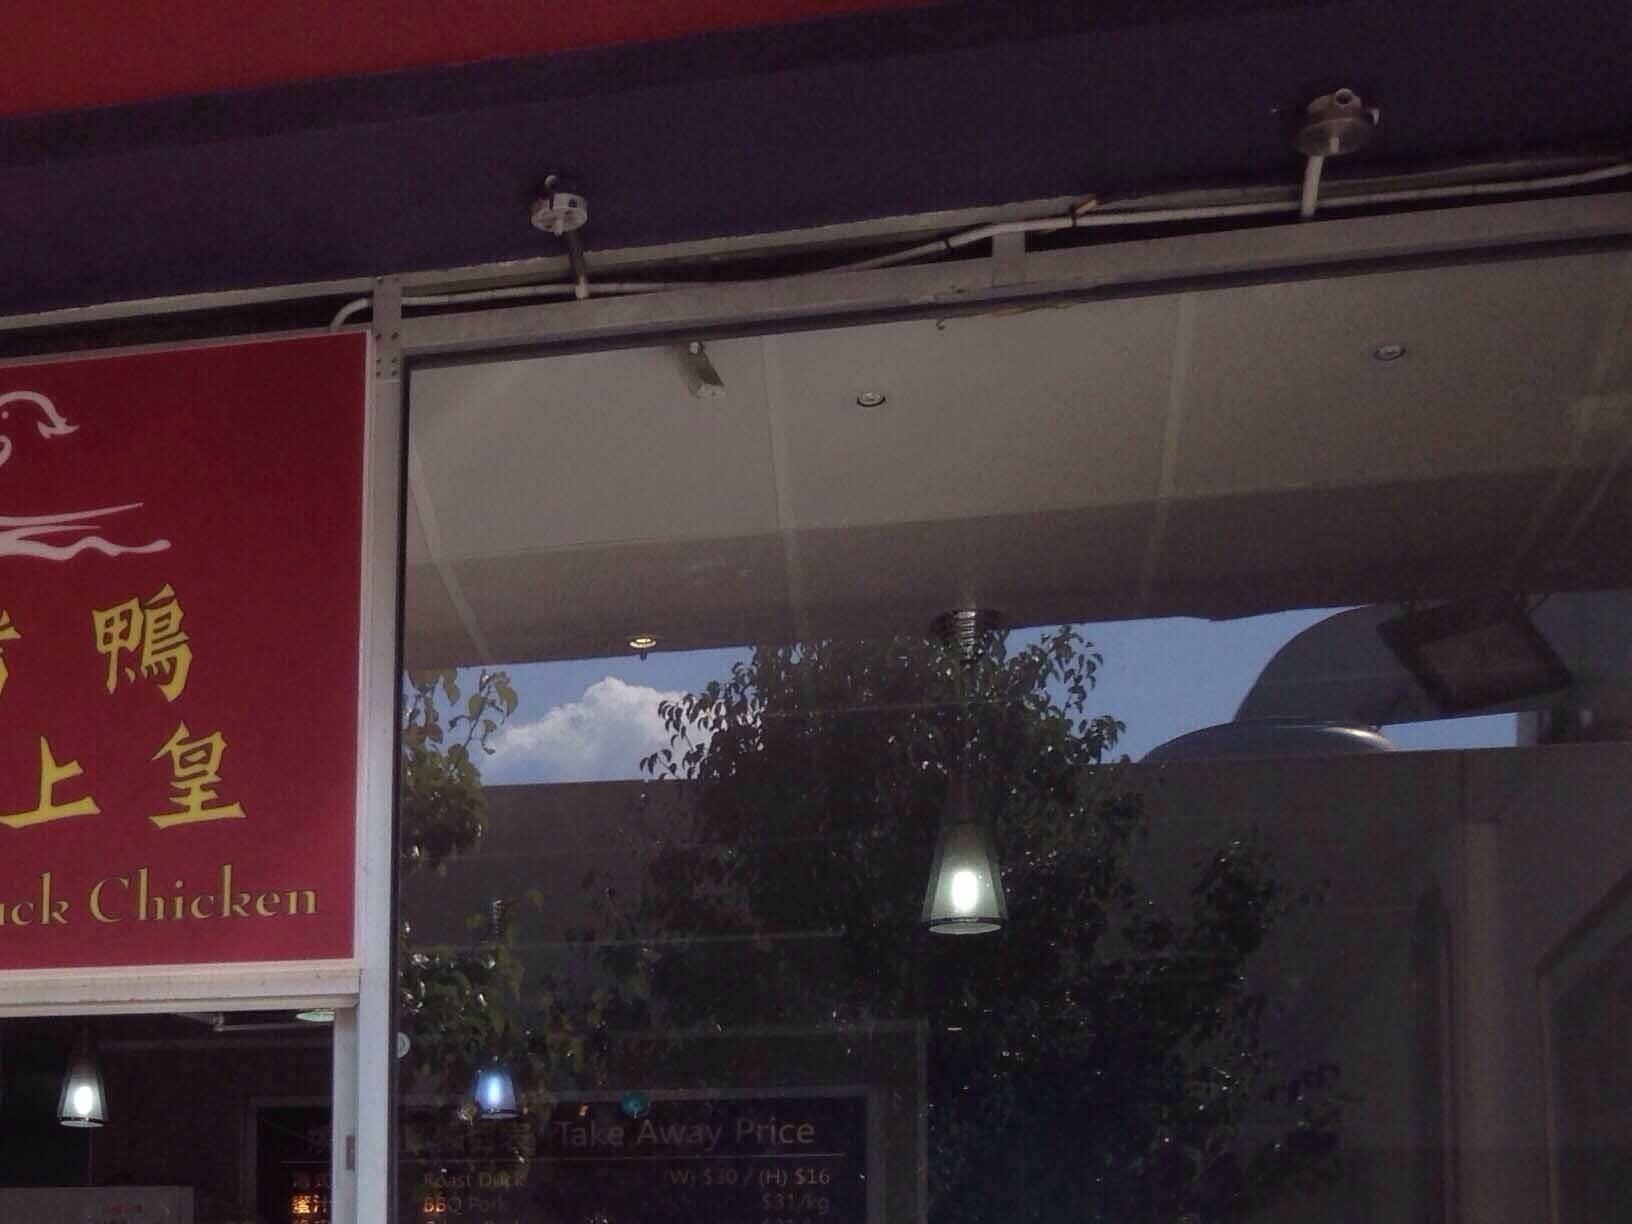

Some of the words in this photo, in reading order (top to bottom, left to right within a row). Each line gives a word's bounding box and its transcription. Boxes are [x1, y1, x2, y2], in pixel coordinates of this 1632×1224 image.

[89, 863, 319, 925] Chicken
[558, 1119, 624, 1148] Take
[636, 1117, 723, 1151] Away
[735, 1115, 817, 1146] Price
[794, 1167, 831, 1186] $16
